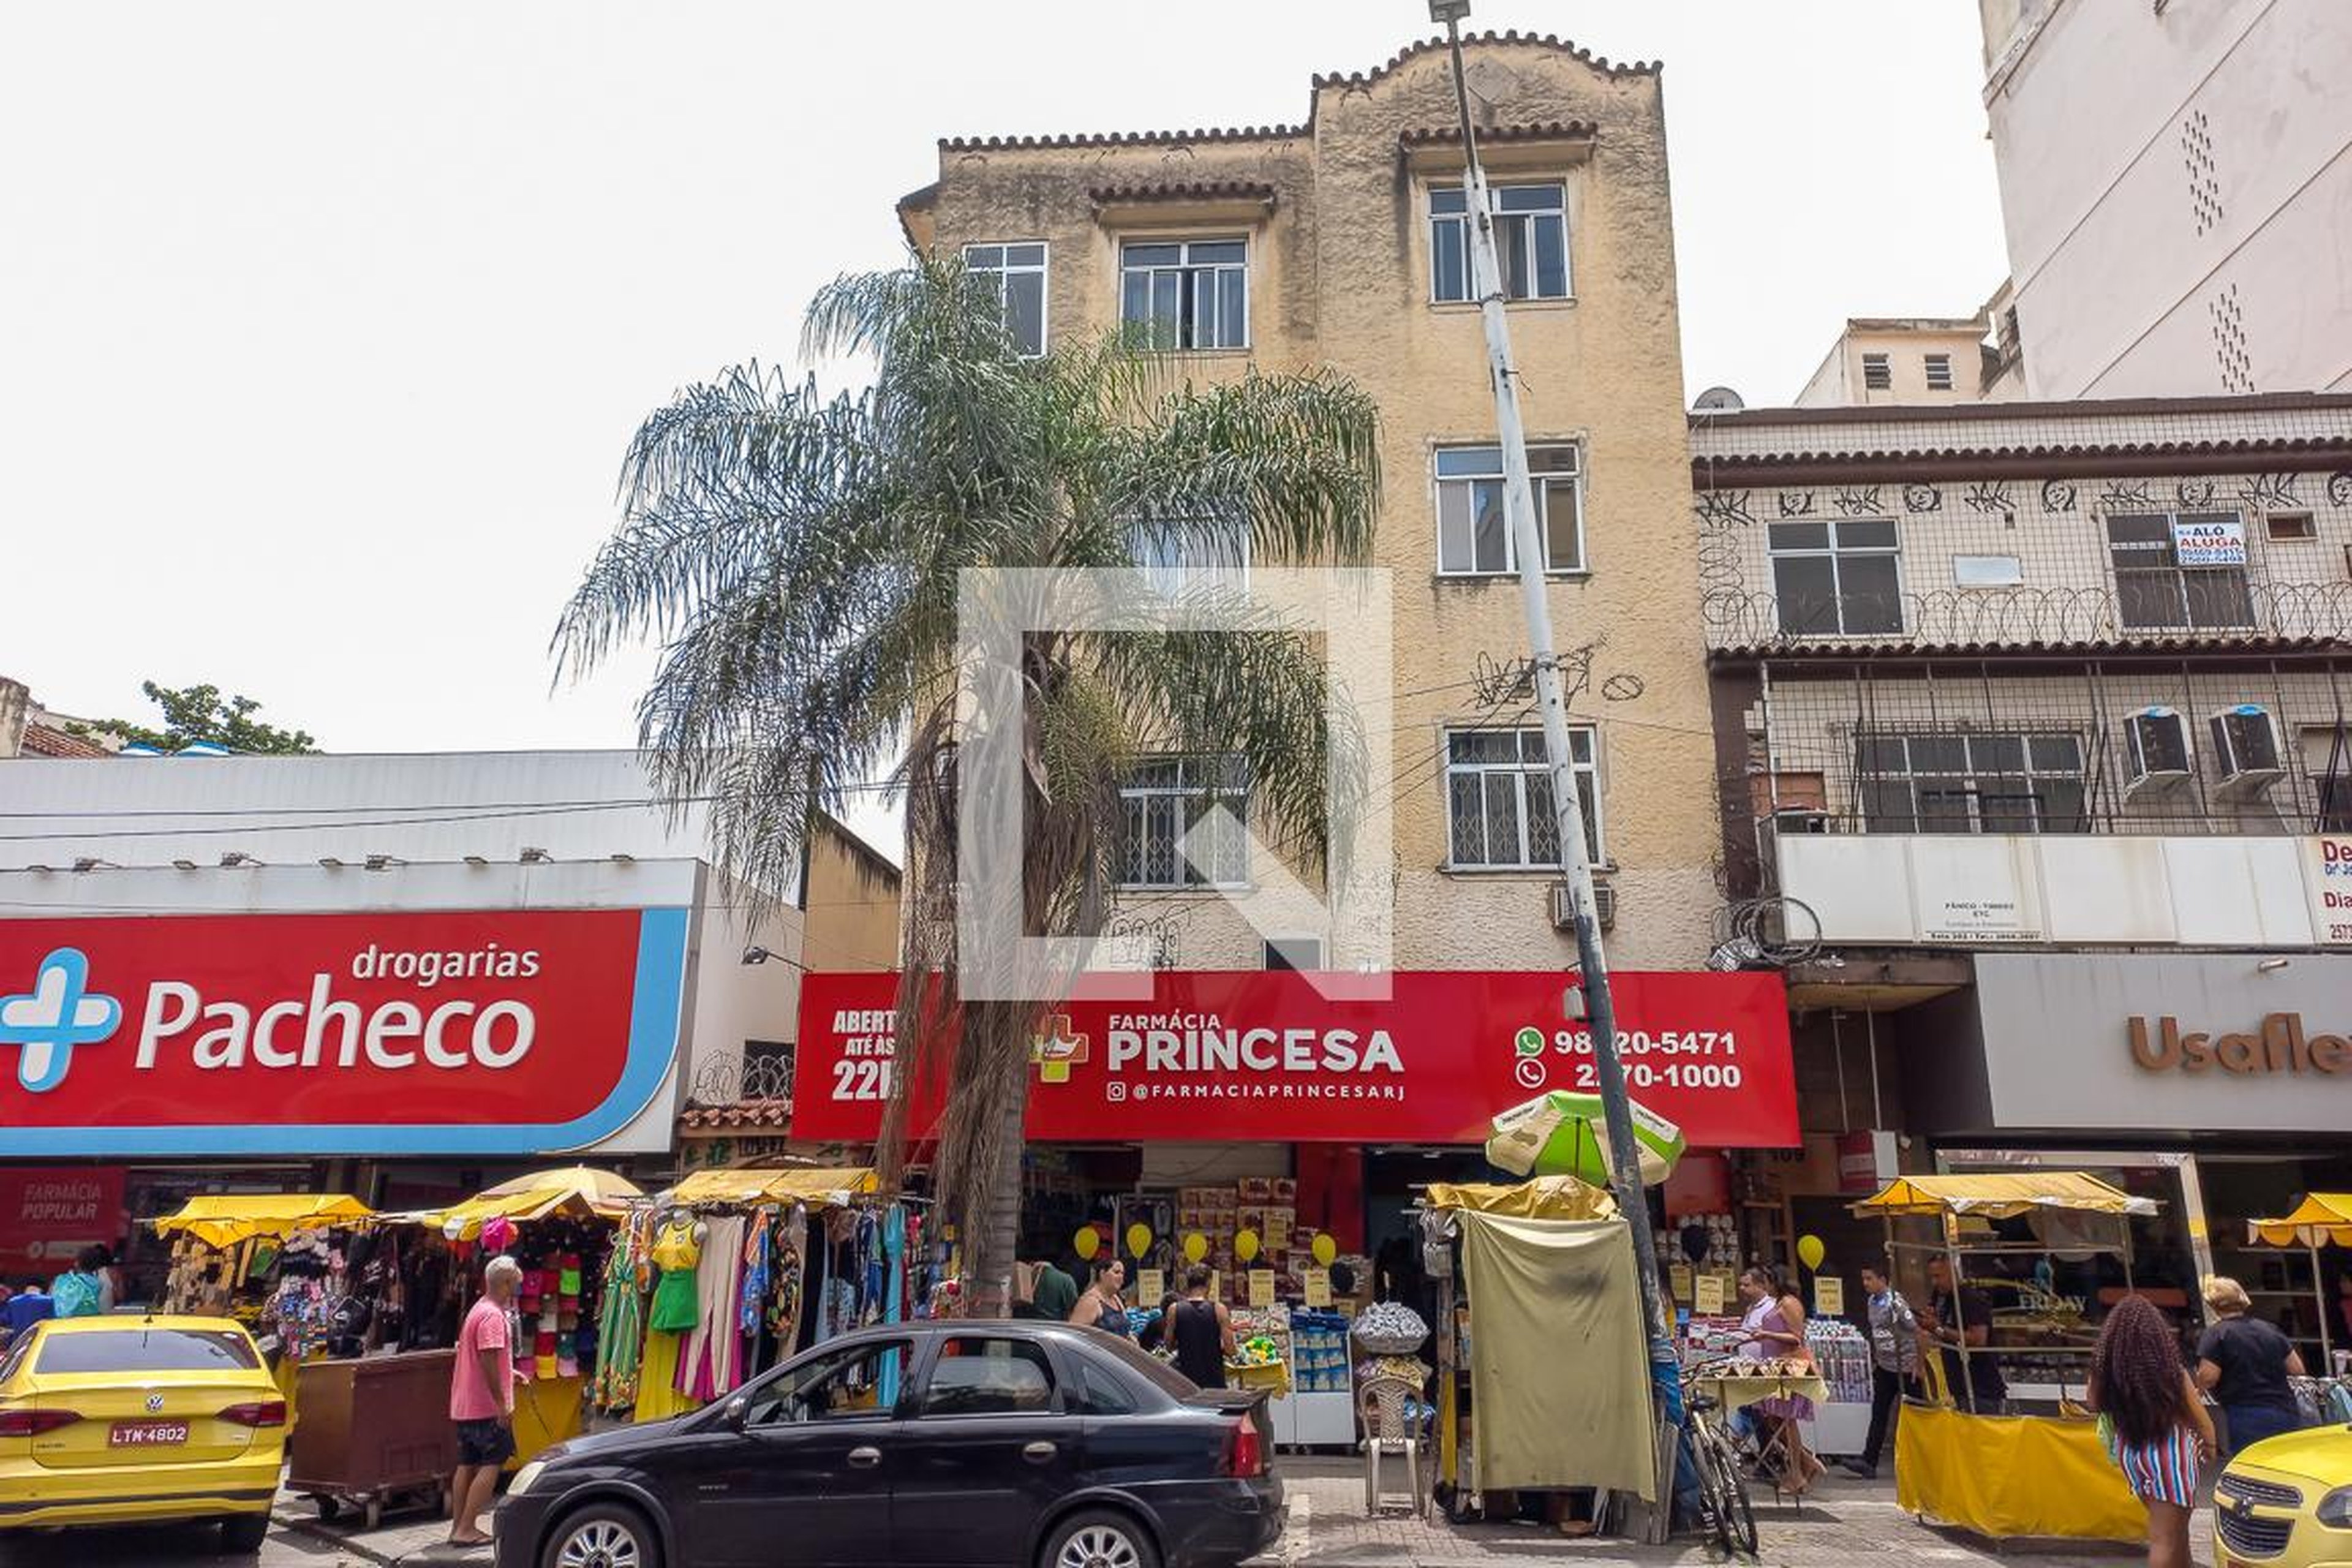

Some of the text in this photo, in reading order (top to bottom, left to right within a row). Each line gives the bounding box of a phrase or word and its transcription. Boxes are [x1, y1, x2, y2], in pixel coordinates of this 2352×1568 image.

[2180, 538, 2241, 548] ALUGA
[352, 944, 541, 986] drogarias
[135, 973, 536, 1070] Pacheco
[832, 1010, 898, 1034] ABERT
[1109, 1009, 1222, 1030] FARMÁCIA
[845, 1034, 896, 1056] ATÉ ÀS
[1107, 1028, 1405, 1072] PRINCESA
[1554, 1031, 1736, 1055] 9820-5471
[2128, 1012, 2352, 1074] Usafle
[1575, 1063, 1742, 1088] 270-1000
[1133, 1084, 1405, 1101] @FARMACIAPRINCESARJ
[21, 1203, 98, 1220] POPULAR
